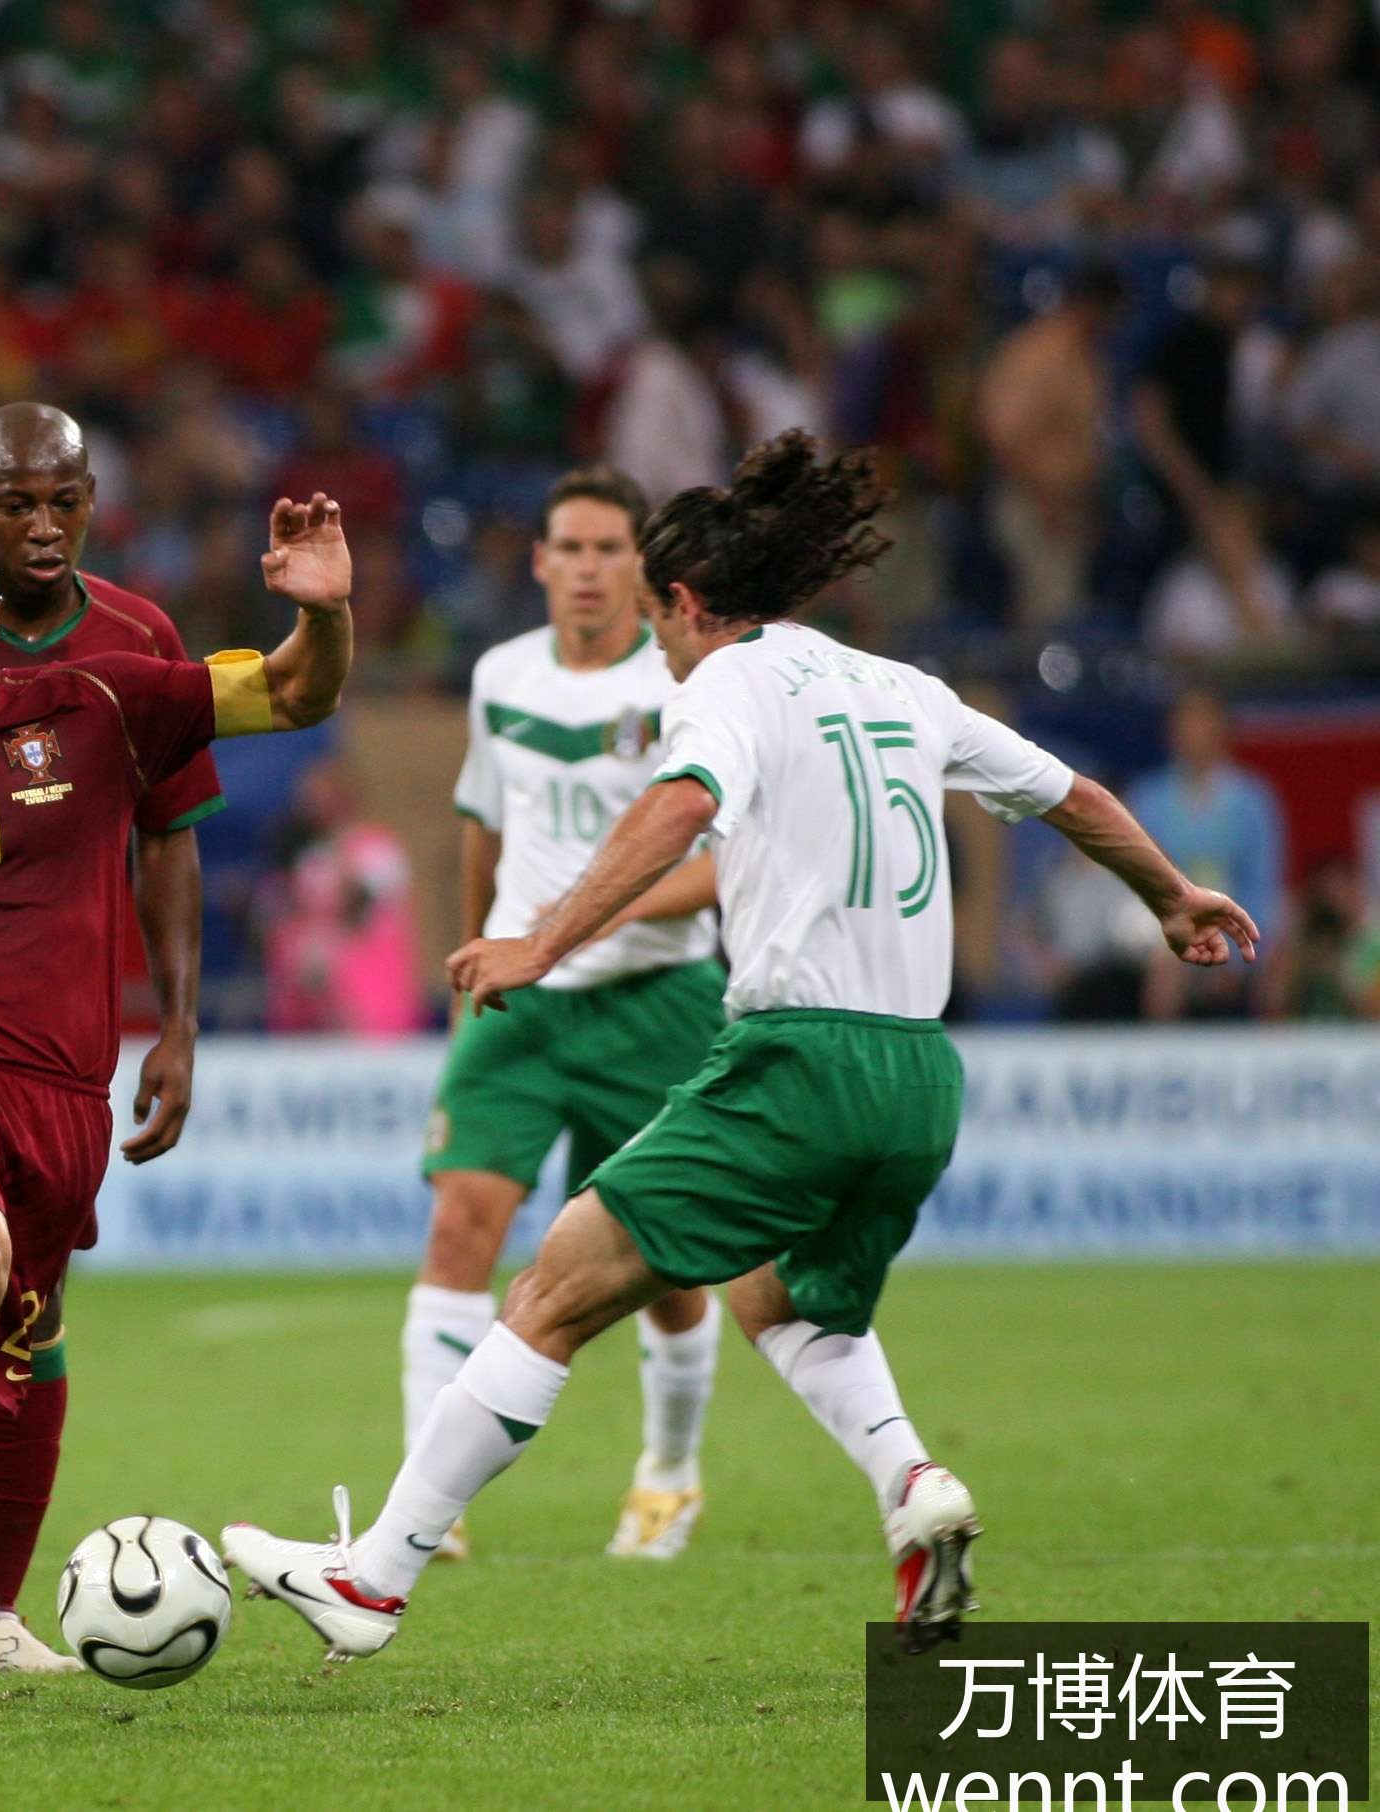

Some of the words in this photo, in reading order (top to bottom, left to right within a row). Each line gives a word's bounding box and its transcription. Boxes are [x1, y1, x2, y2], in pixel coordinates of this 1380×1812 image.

[546, 777, 605, 843] 10
[816, 713, 937, 918] 15
[0, 1290, 40, 1361] 2
